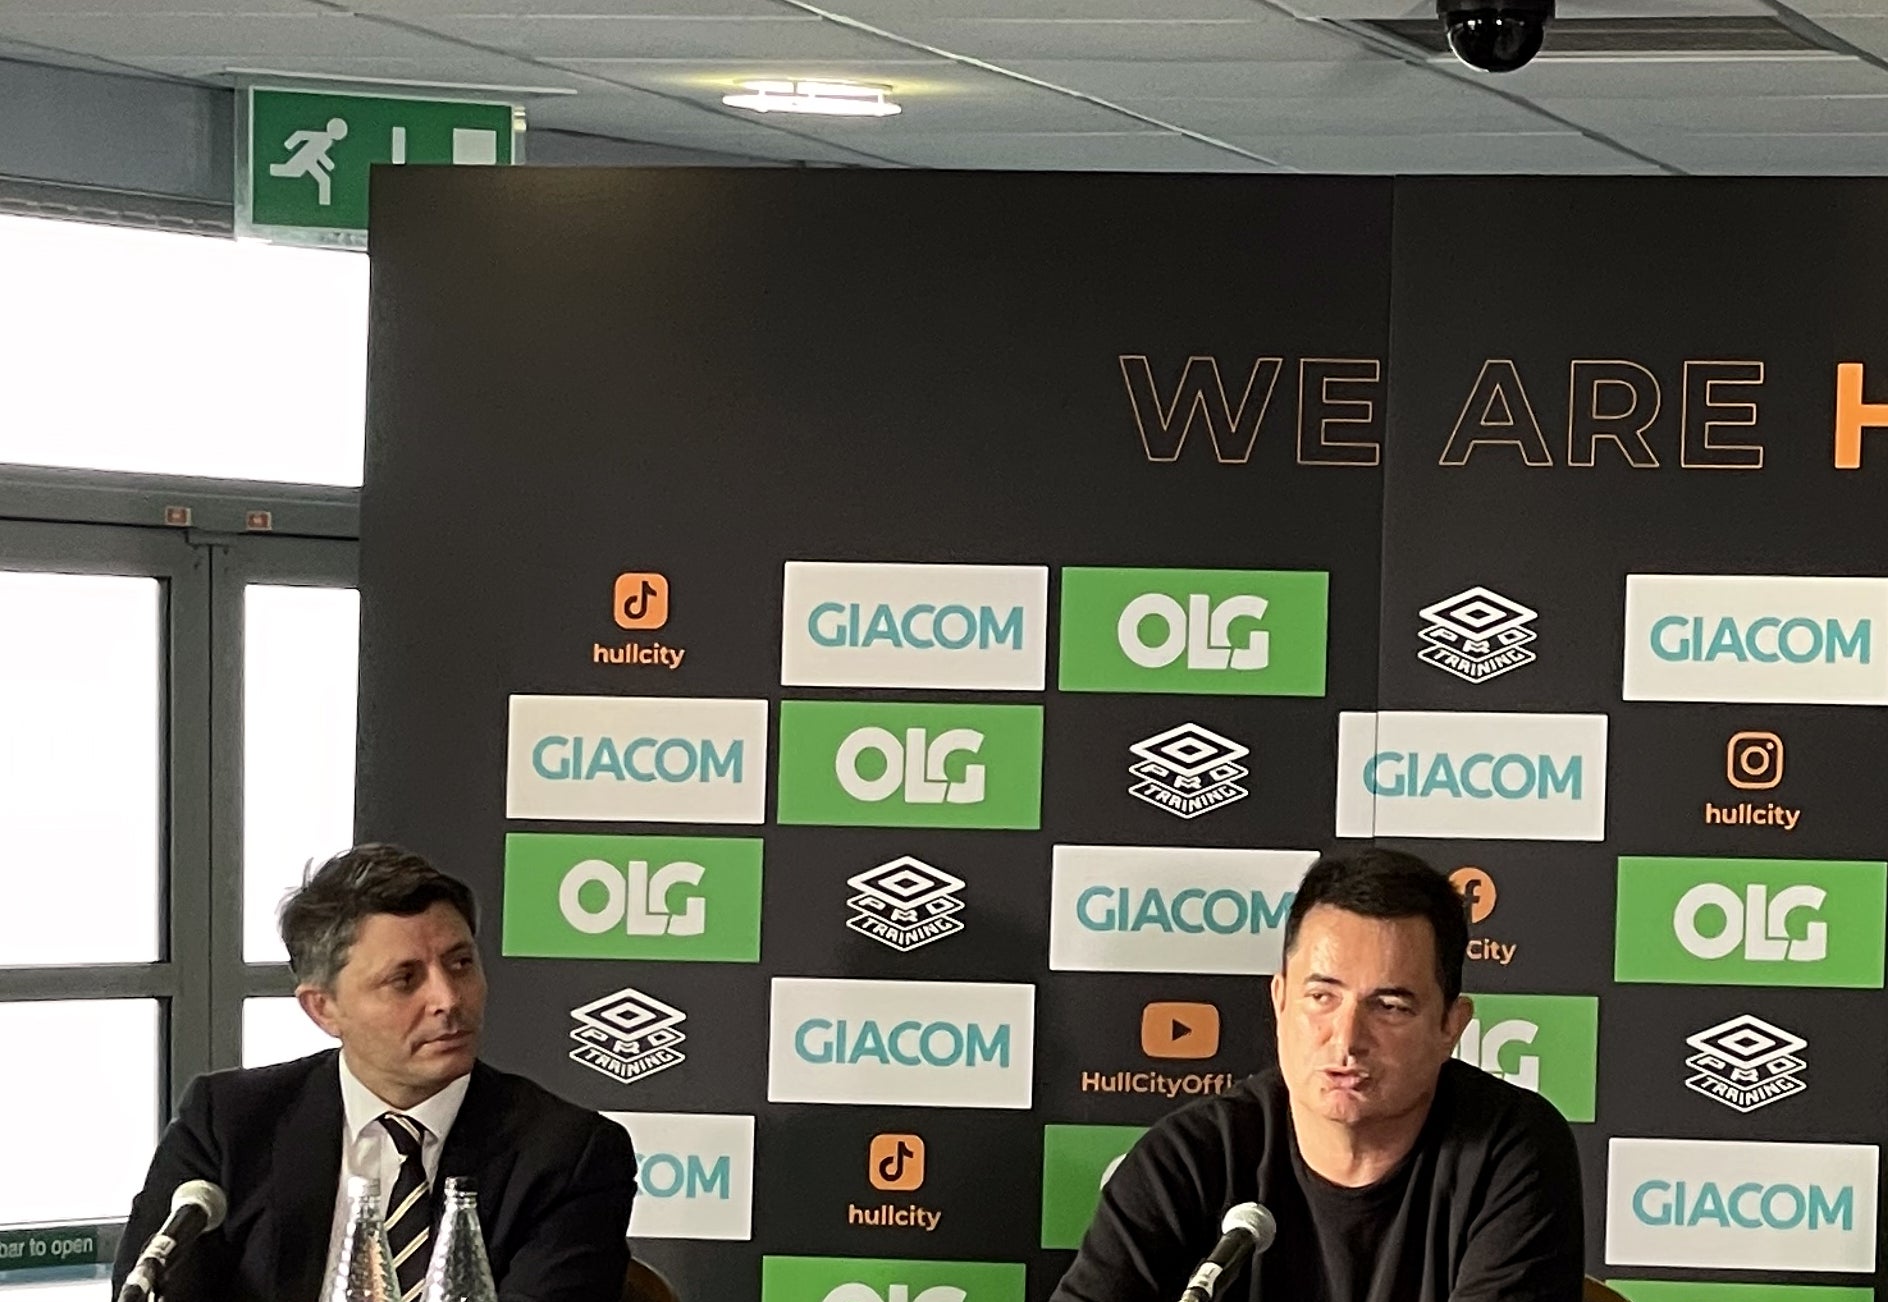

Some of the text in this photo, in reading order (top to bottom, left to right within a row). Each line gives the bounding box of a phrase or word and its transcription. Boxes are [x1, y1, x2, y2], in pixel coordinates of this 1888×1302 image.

[1118, 356, 1380, 466] WE
[1438, 359, 1764, 468] ARE
[810, 605, 1022, 648] GIACOM
[1118, 593, 1269, 670] OLG
[1428, 626, 1529, 655] PRO
[1652, 617, 1869, 662] GIACOM
[594, 643, 684, 669] hullcity
[1432, 647, 1526, 678] TRAINING
[535, 740, 741, 780] GIACOM
[836, 727, 985, 803] OLG
[1365, 753, 1581, 797] GIACOM
[1139, 762, 1241, 790] PRO
[1143, 782, 1238, 813] TRAINING
[1706, 803, 1800, 830] hullcity
[559, 860, 705, 936] OLG
[856, 895, 957, 923] PRO
[1078, 888, 1296, 932] GIACOM
[860, 915, 954, 946] TRAINING
[1674, 883, 1826, 961] OLG
[1467, 938, 1517, 965] City
[578, 1027, 678, 1056] PRO
[796, 1021, 1008, 1065] GIACOM
[583, 1048, 675, 1079] TRAINING
[1695, 1055, 1799, 1083] PRO
[1699, 1076, 1796, 1107] TRAINING
[849, 1205, 940, 1231] hullcity
[1634, 1182, 1852, 1228] GIACOM
[29, 1238, 46, 1257] to
[51, 1237, 93, 1260] open
